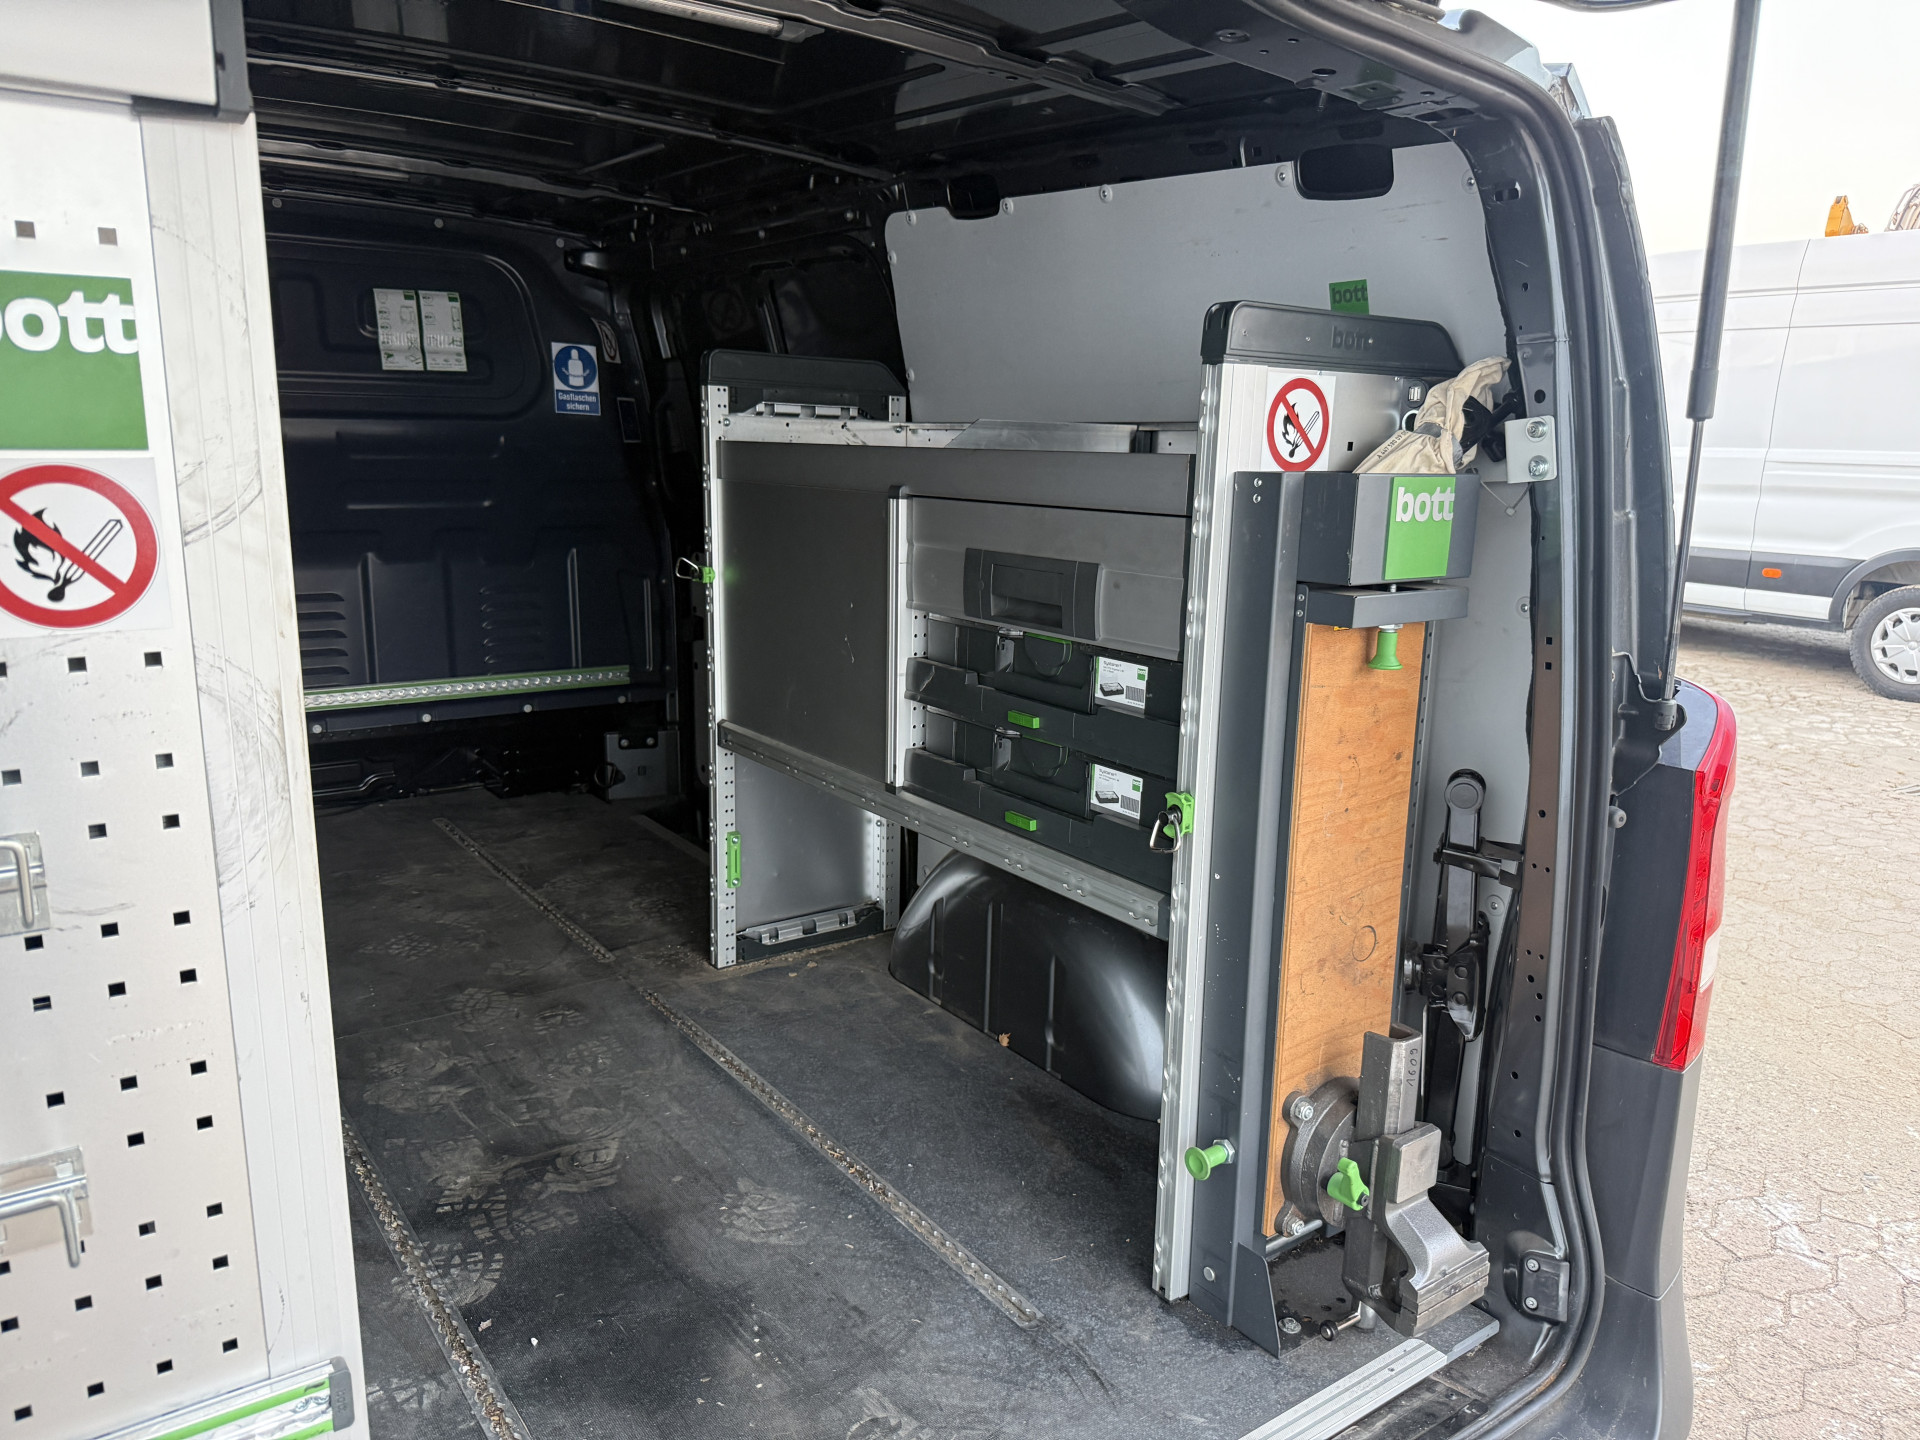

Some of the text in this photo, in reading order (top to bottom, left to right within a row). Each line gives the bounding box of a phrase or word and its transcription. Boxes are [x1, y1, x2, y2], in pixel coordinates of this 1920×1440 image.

[1332, 285, 1368, 304] bott
[0, 290, 139, 354] ott
[1331, 325, 1370, 351] bott
[558, 392, 597, 402] Gasflaschen
[566, 402, 590, 411] sichern
[1395, 486, 1455, 522] bott
[1406, 1048, 1418, 1086] 1609
